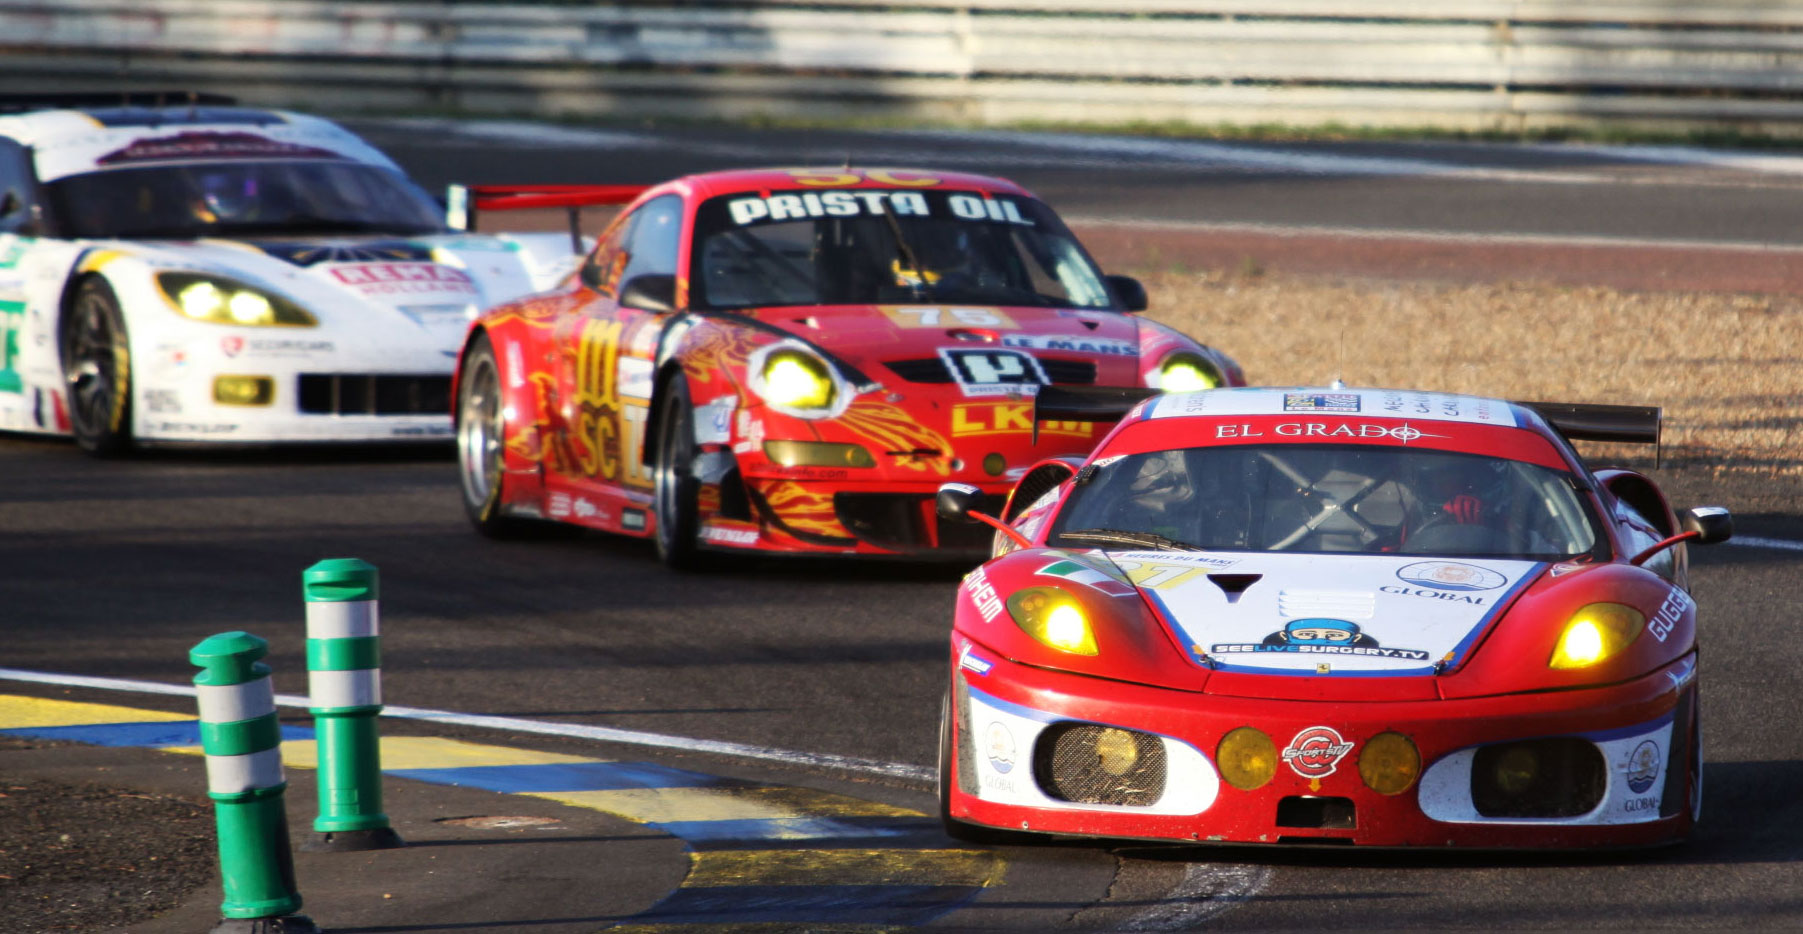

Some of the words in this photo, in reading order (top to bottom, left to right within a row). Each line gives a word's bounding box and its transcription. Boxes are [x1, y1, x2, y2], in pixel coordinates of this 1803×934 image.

[729, 191, 930, 225] PRISTA
[949, 195, 1036, 225] OIL
[896, 308, 1001, 326] 75
[1003, 338, 1034, 348] LE
[1047, 340, 1140, 356] MANS
[1215, 423, 1263, 438] EL
[1274, 421, 1423, 443] GRADO
[1380, 585, 1487, 605] GLOBAL
[1215, 645, 1426, 660] SEELIVESURGERY.TV
[1624, 797, 1660, 813] GLOBAL
